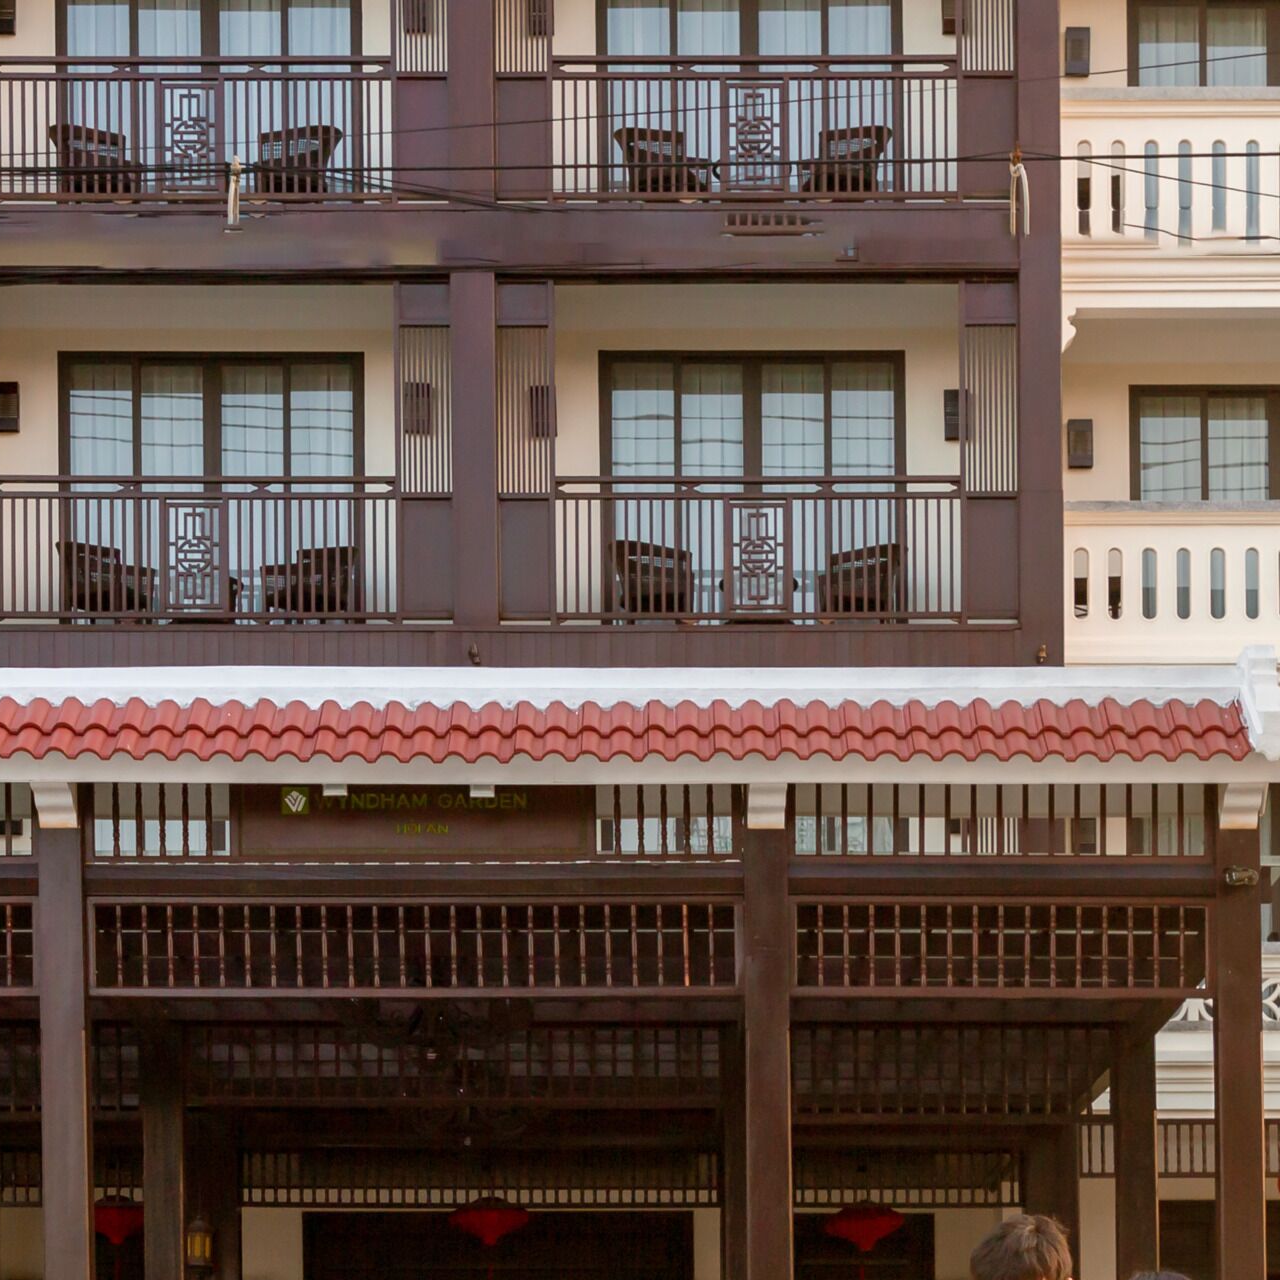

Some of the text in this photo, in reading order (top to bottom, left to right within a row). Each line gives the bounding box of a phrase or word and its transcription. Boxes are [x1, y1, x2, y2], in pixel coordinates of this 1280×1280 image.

[316, 792, 528, 809] WYNDHAM GARDEN
[426, 823, 449, 834] AN
